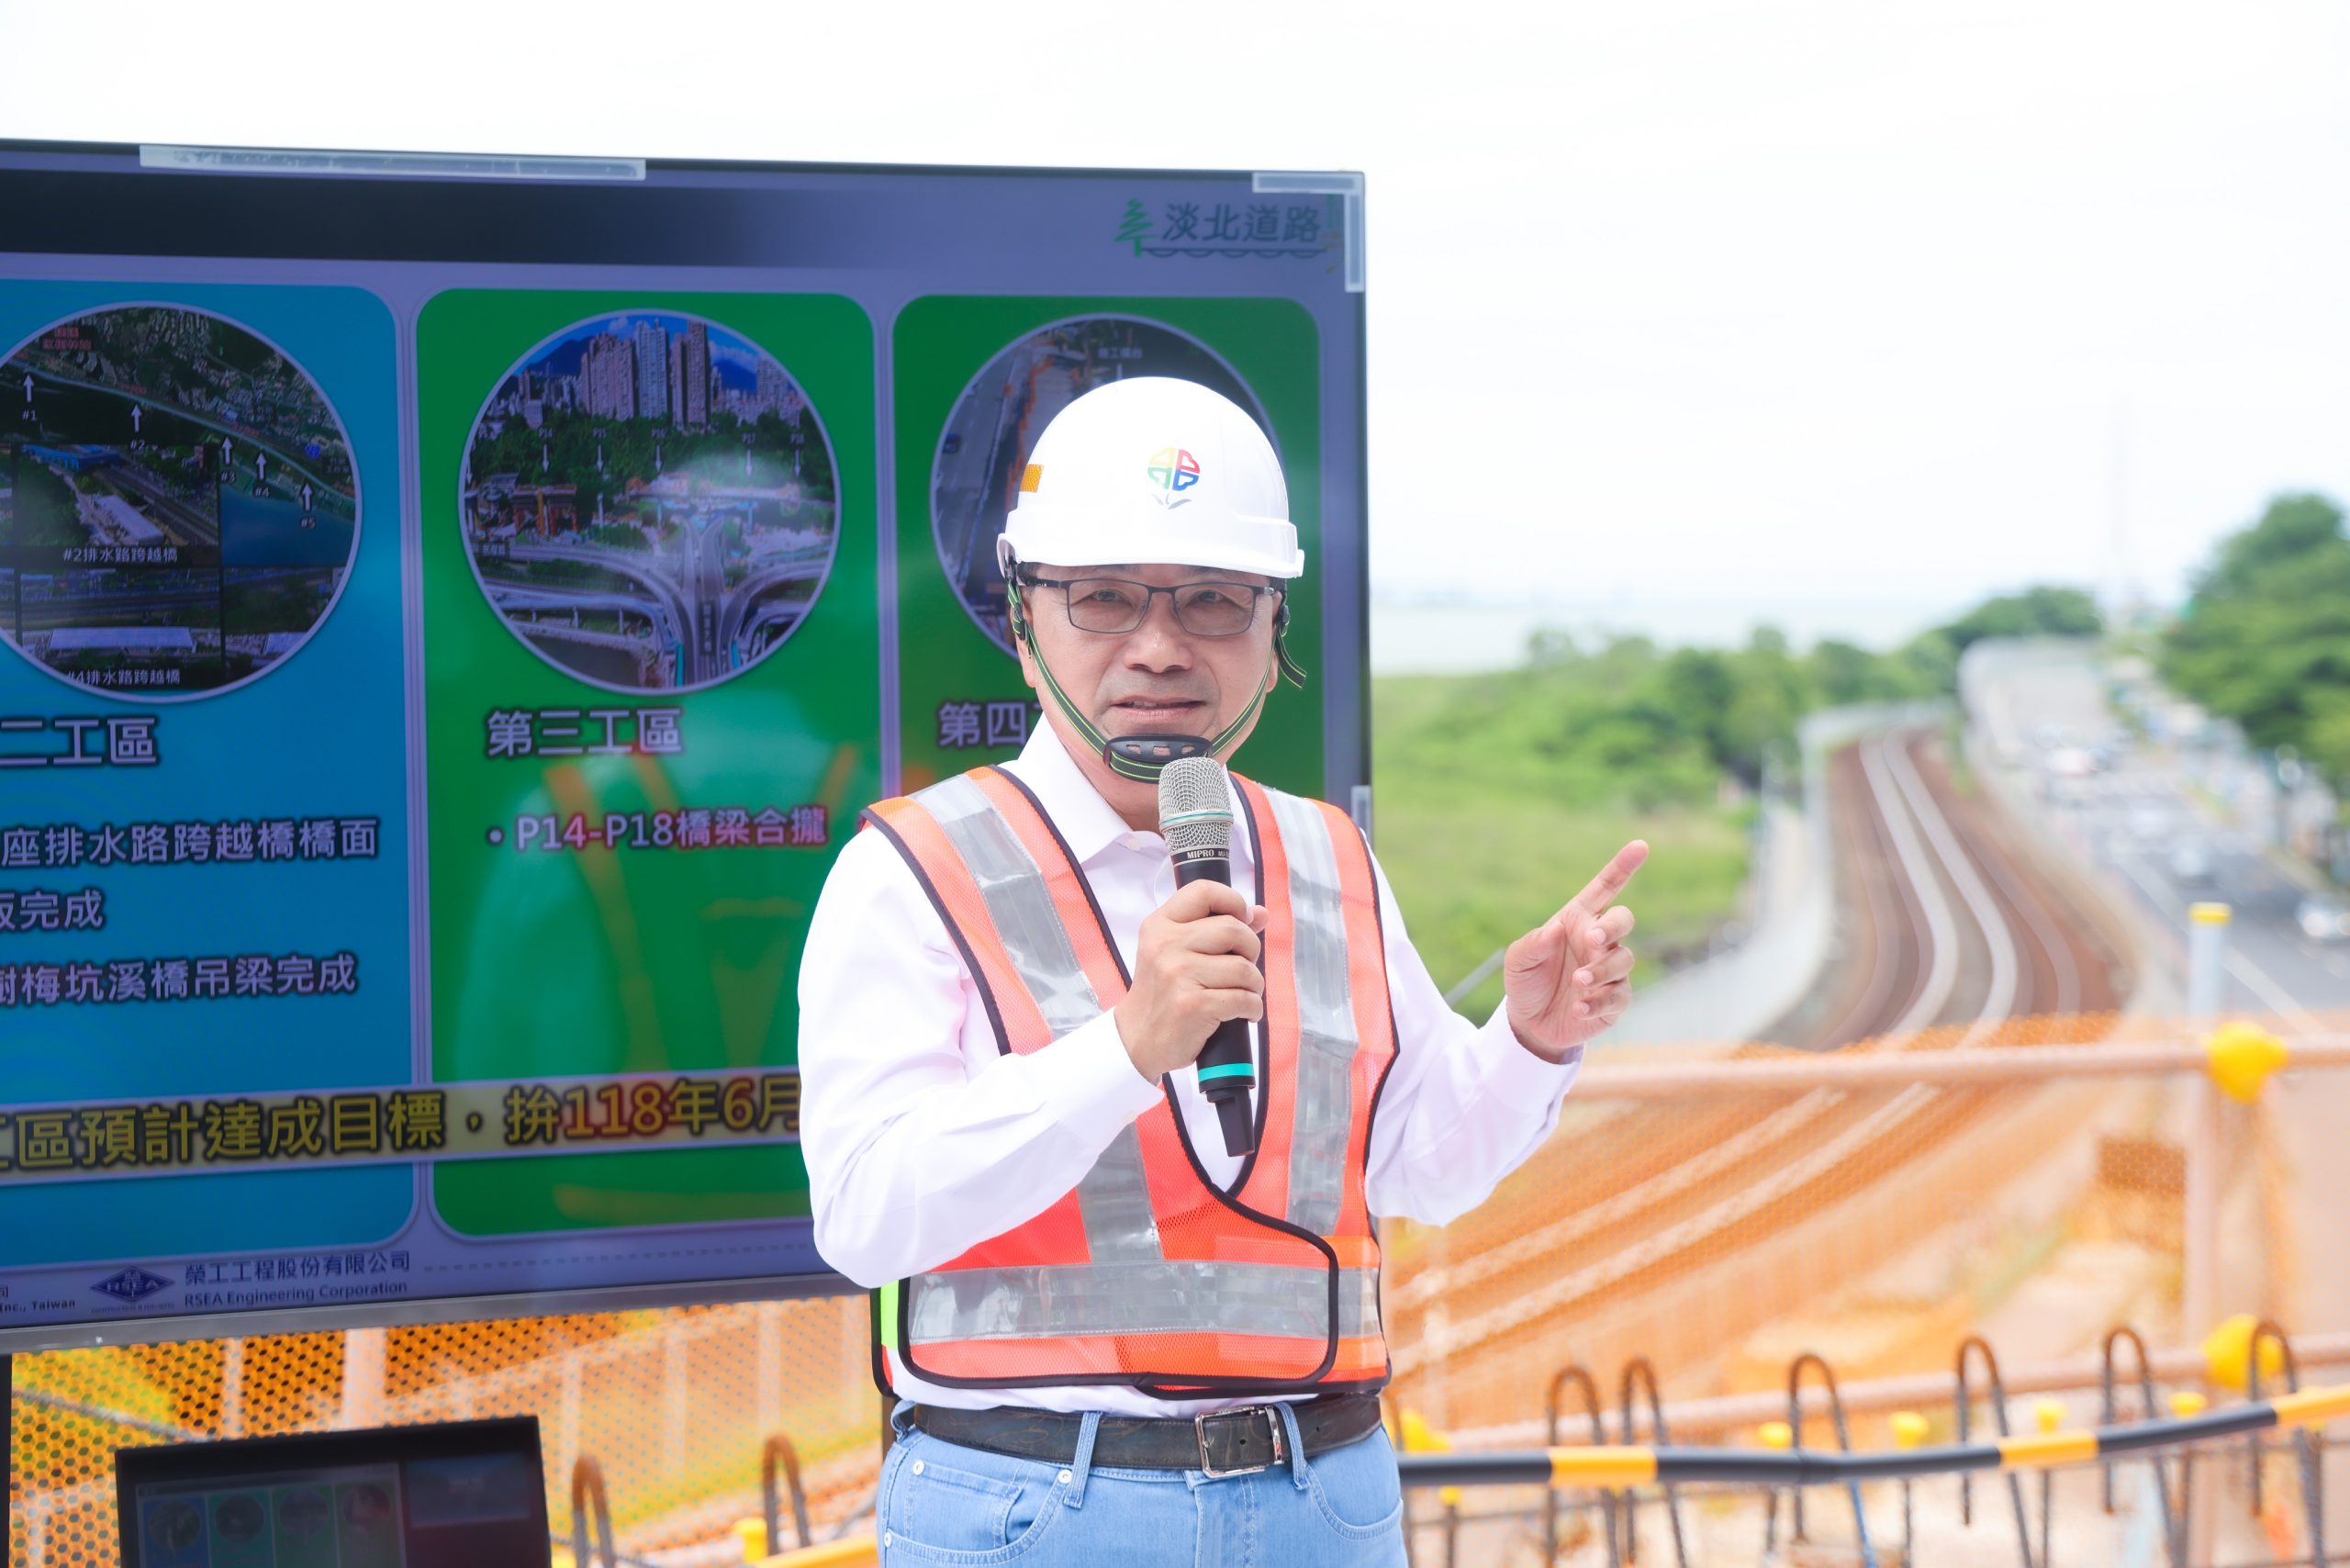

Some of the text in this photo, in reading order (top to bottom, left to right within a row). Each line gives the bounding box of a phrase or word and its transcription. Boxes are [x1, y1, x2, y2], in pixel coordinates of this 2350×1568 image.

[1162, 203, 1322, 243] 淡北道路
[22, 409, 37, 421] #1
[130, 440, 145, 451] #2
[220, 471, 236, 483] #3
[255, 487, 270, 498] #4
[301, 518, 316, 530] #5
[62, 546, 178, 563] #2排水路跨越橋
[487, 708, 682, 756] 第三工區
[939, 702, 1043, 748] 第四
[0, 718, 158, 766] 二工區
[516, 807, 827, 849] P14-P18橋梁合攏
[1, 818, 378, 868] 座排水路跨越橋橋面
[1186, 849, 1214, 860] MIPRO
[0, 1076, 800, 1170] 區預計達成目標，拚118年6月
[185, 1250, 410, 1286] 榮工工程股份有限公司
[31, 1299, 76, 1311] Taiwan
[185, 1292, 223, 1308] RSEA
[228, 1285, 315, 1306] Engineering
[319, 1281, 408, 1301] Corporation
